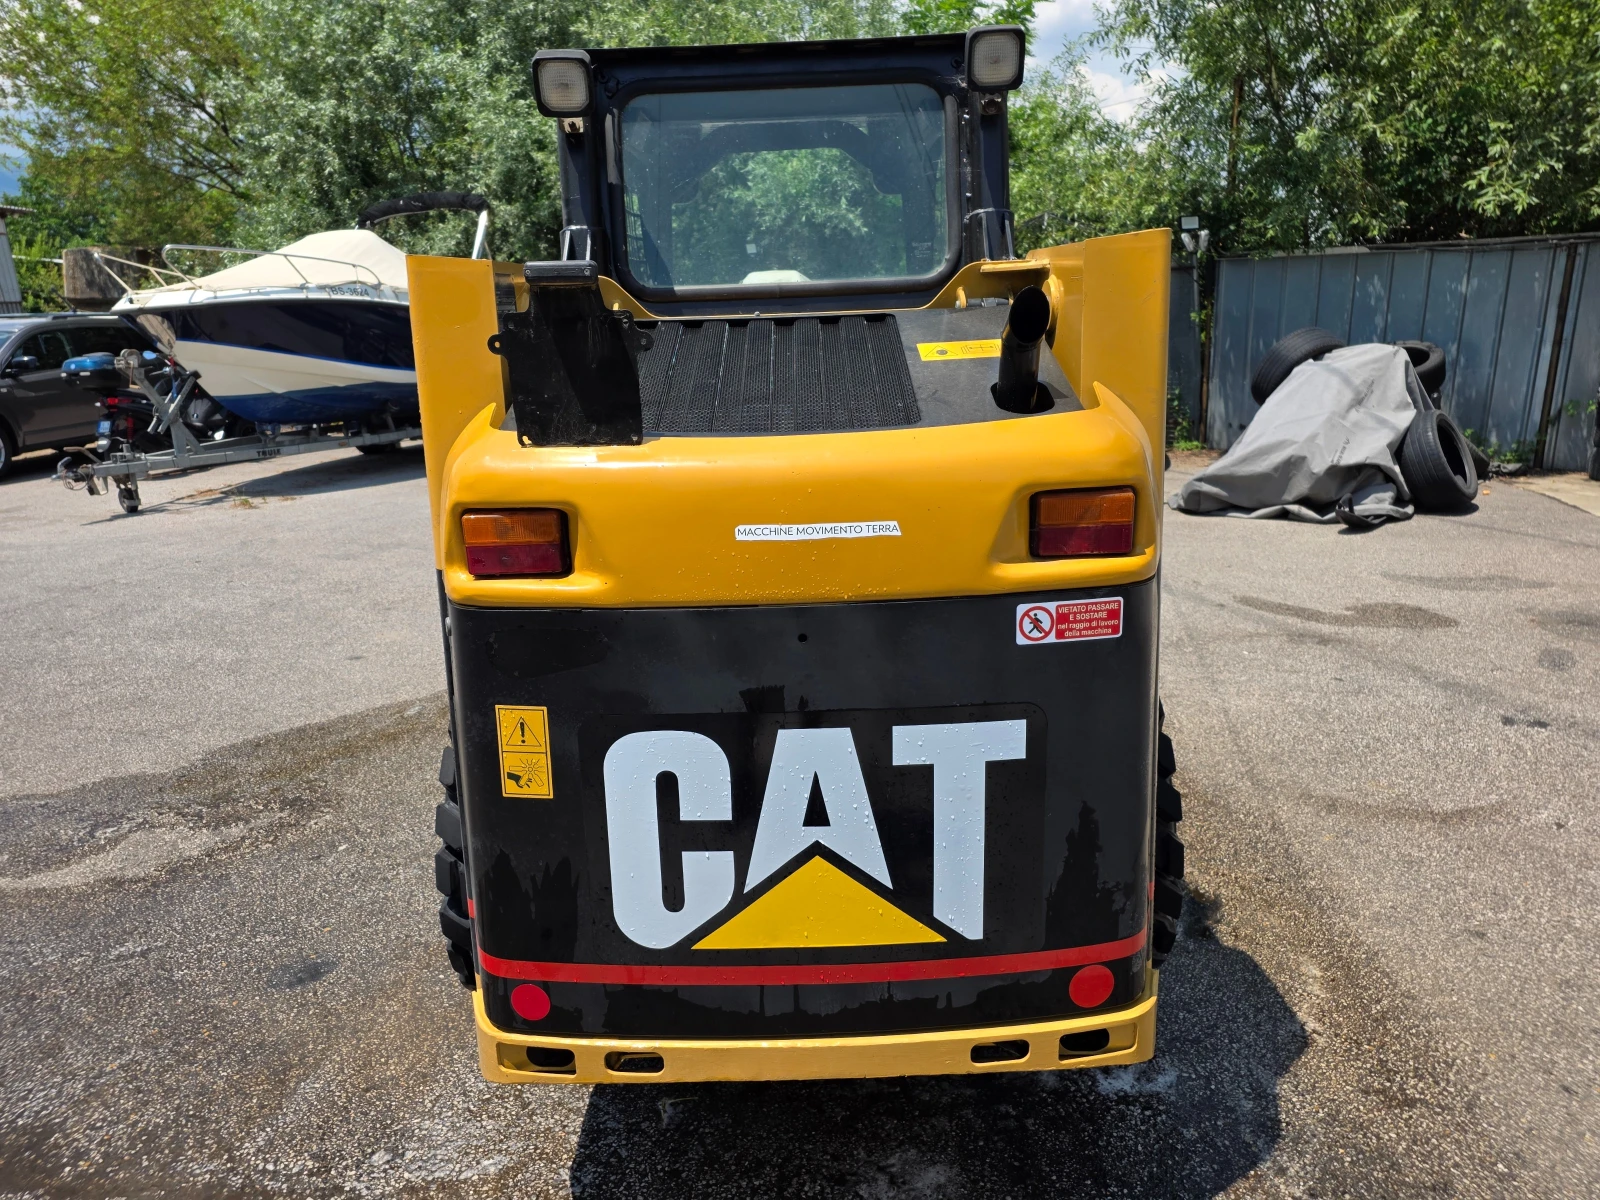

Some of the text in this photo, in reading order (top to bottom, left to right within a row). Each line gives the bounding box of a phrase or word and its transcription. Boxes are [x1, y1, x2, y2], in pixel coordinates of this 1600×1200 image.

[737, 524, 899, 537] MACCHINE MOVIMENTO TERRA
[1088, 602, 1119, 611] PASSARE
[1076, 612, 1108, 620] SOSTARE
[1069, 621, 1090, 630] raggio
[603, 719, 1027, 949] CAT
